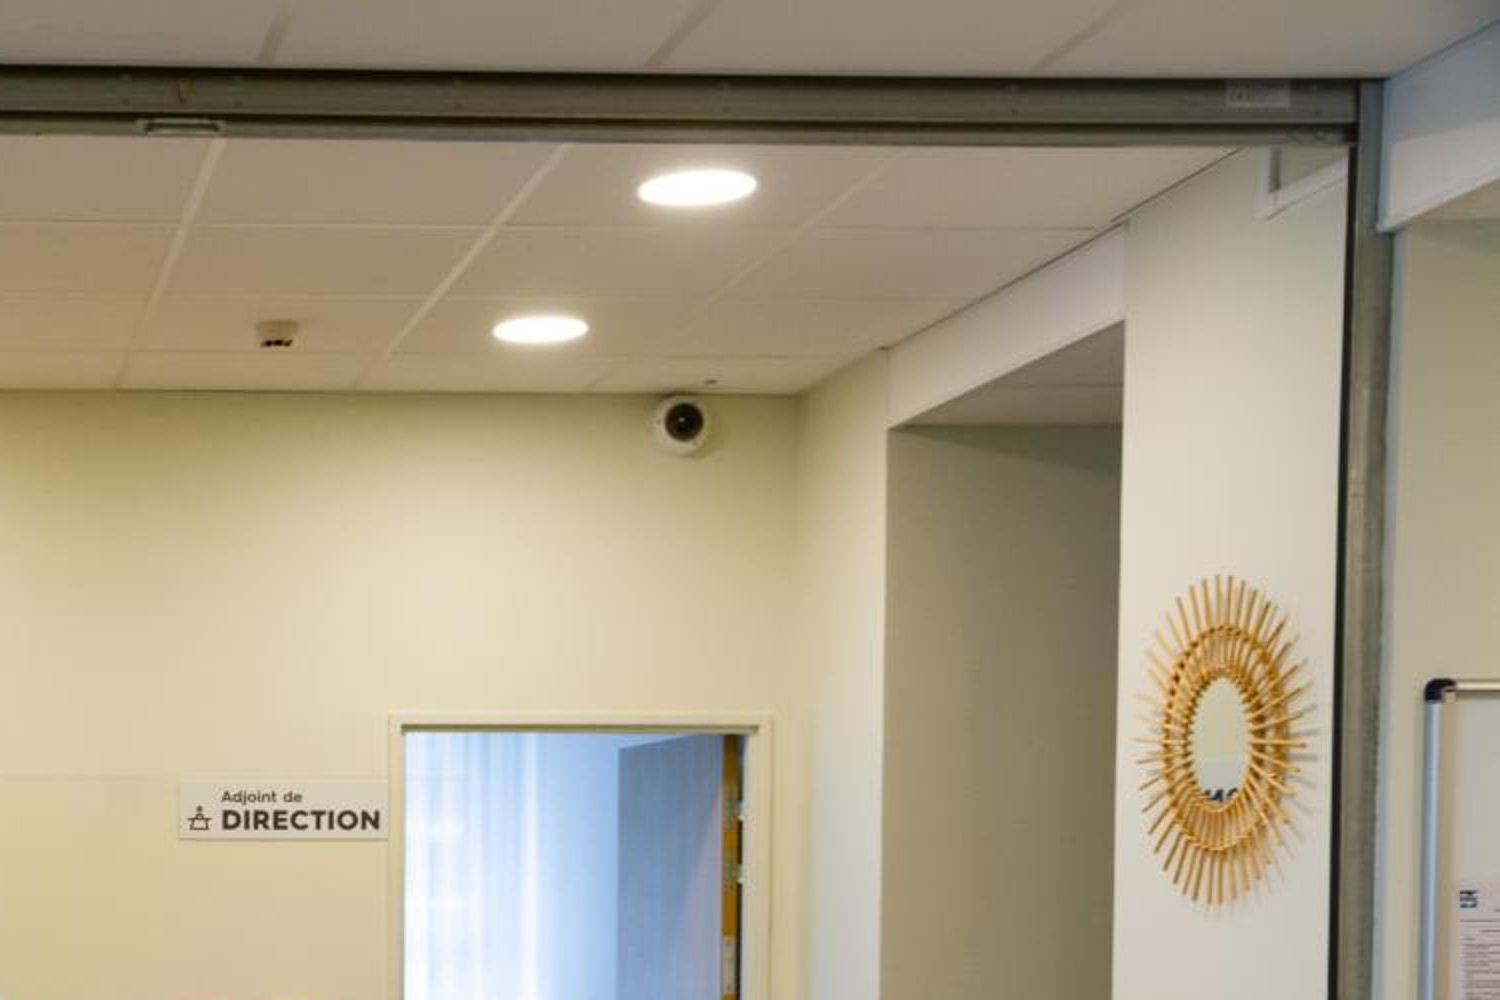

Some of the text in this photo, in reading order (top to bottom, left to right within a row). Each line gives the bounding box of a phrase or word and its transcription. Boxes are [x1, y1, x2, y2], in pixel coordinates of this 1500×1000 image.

[220, 790, 304, 806] Adjoint de
[221, 809, 381, 831] DIRECTION
